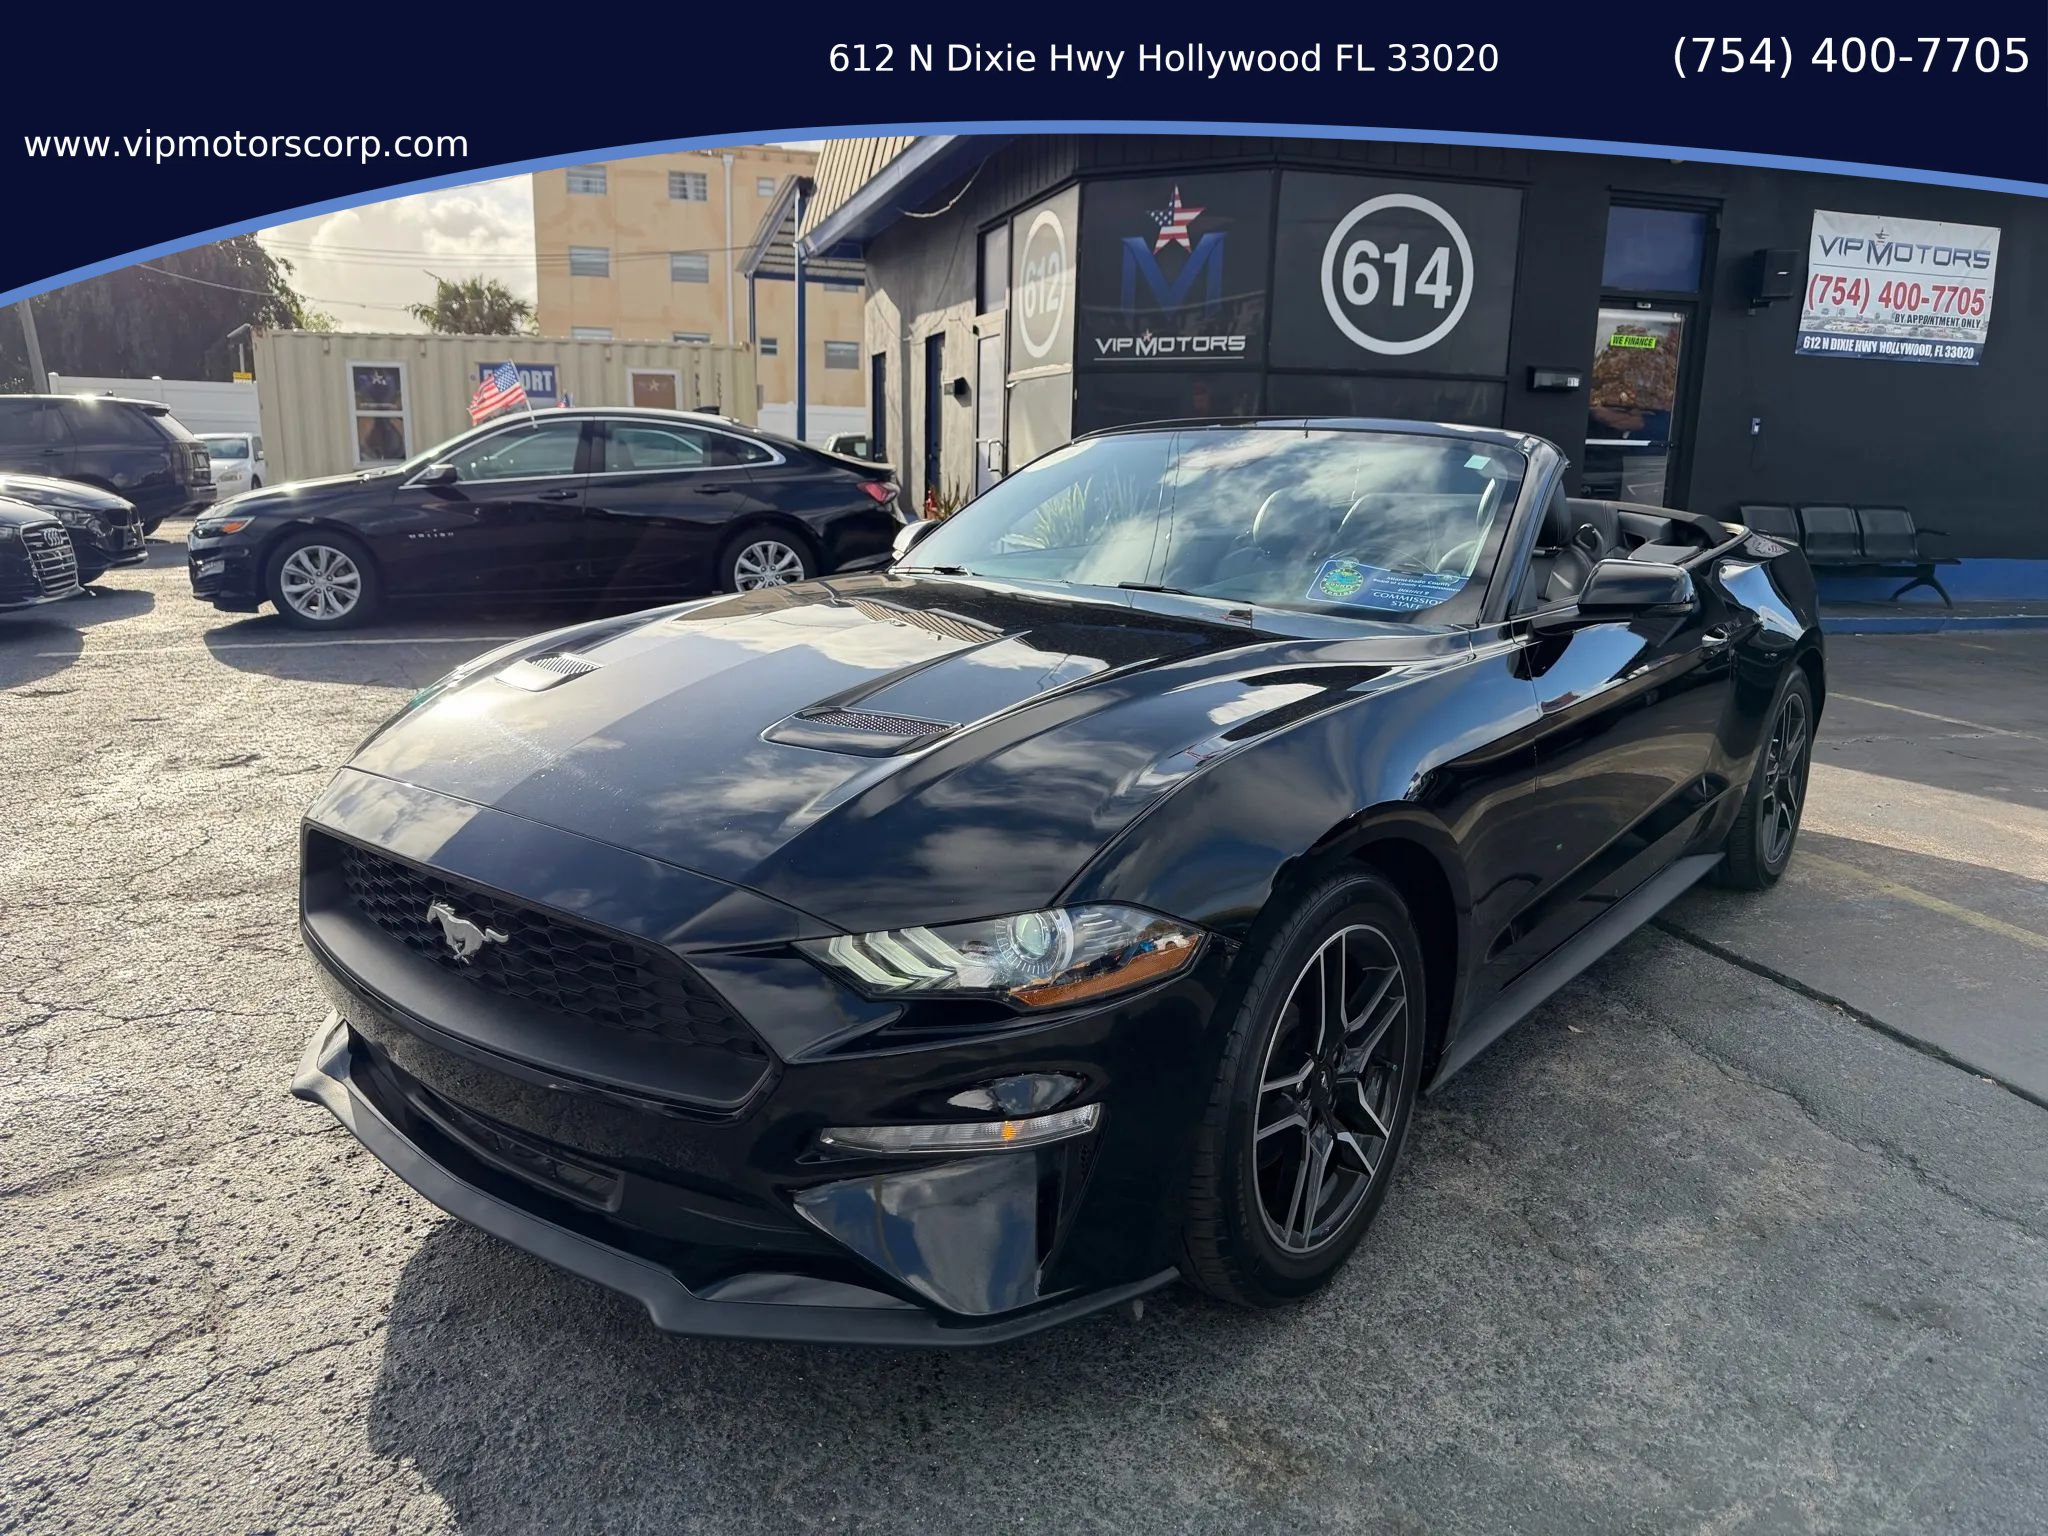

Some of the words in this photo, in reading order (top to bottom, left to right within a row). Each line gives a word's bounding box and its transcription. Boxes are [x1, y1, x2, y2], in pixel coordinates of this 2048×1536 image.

[1819, 234, 1864, 258] VIP
[1867, 239, 1991, 269] MOTORS
[1023, 251, 1060, 319] 612
[1342, 240, 1453, 309] 614
[1808, 273, 1870, 314] (754)
[1878, 280, 1986, 316] 400-7705
[1895, 313, 1906, 324] BY
[1907, 314, 1960, 327] APPOINTMENT
[1961, 318, 1981, 329] ONLY
[1095, 337, 1133, 354] VIP
[1135, 335, 1246, 356] MOTORS
[1613, 335, 1625, 346] WE
[1624, 336, 1653, 347] FINANCE
[1803, 336, 1821, 349] 612
[1822, 337, 1830, 350] N
[1830, 338, 1854, 352] DIXIE
[1854, 339, 1878, 353] HWY
[1934, 345, 1944, 357] FL
[1944, 345, 1974, 359] 33020
[1392, 600, 1423, 610] STAFF
